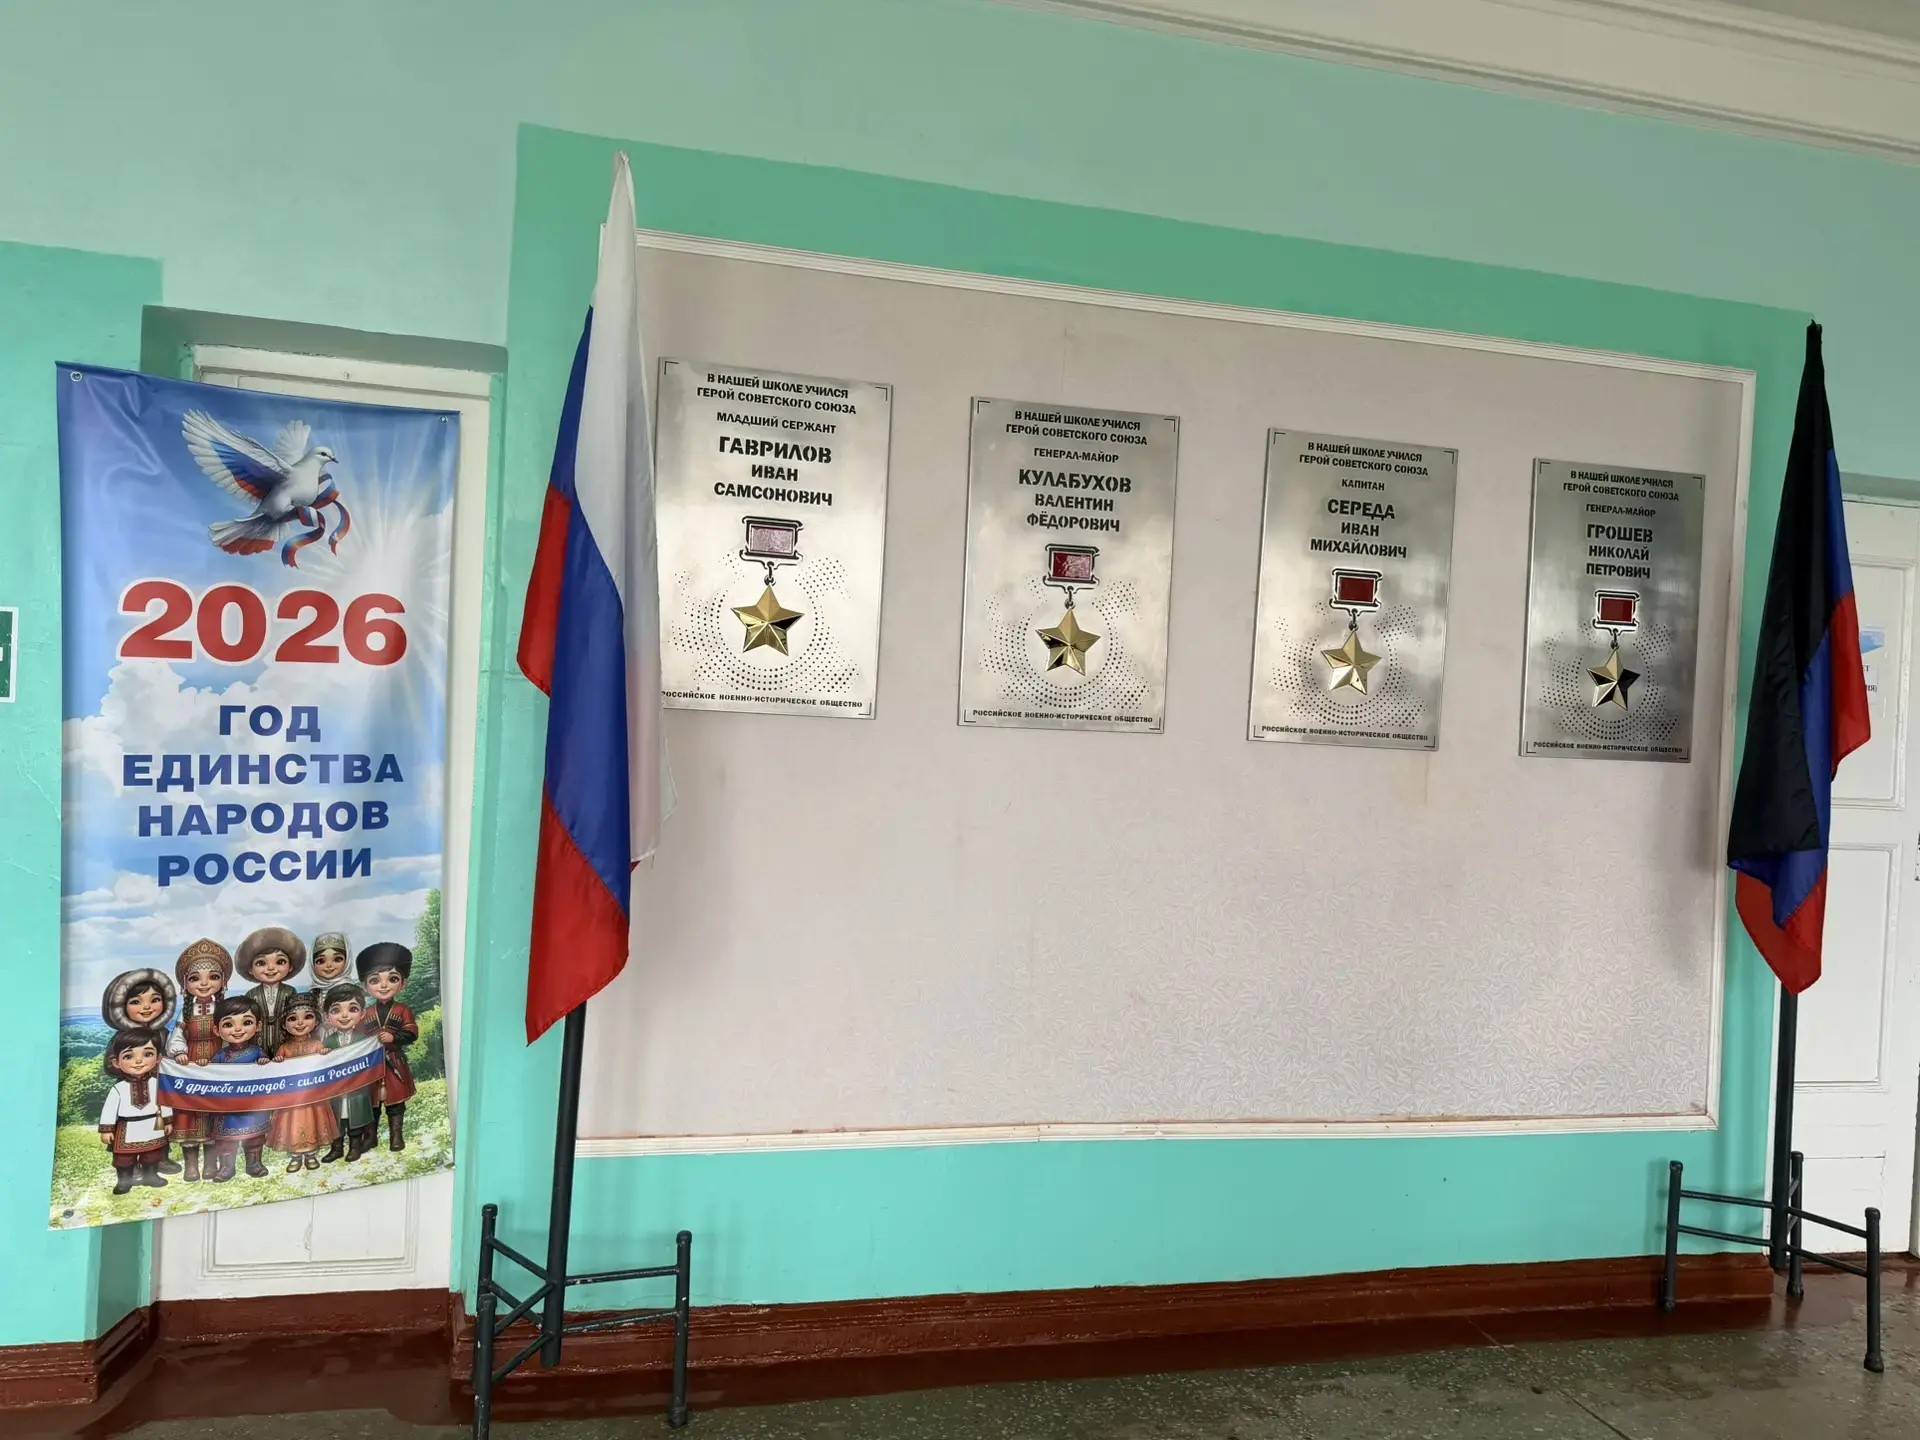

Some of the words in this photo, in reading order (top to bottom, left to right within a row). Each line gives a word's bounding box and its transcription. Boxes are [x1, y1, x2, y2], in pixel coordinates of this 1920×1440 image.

[707, 373, 715, 383] В
[718, 374, 759, 388] НАШЕЙ
[762, 380, 803, 394] ШКОЛЕ
[805, 385, 849, 399] УЧИЛСЯ
[697, 387, 735, 400] ГЕРОЙ
[738, 392, 811, 409] СОВЕТСКОГО
[815, 401, 857, 415] СОЮЗА
[716, 412, 779, 428] МЛАДШИЙ
[781, 419, 836, 434] СЕРЖАНТ
[1015, 411, 1022, 420] В
[1024, 411, 1062, 424] НАШЕЙ
[1064, 415, 1100, 427] ШКОЛЕ
[1102, 418, 1141, 431] УЧИЛСЯ
[1006, 423, 1039, 436] ГЕРОЙ
[1042, 427, 1107, 442] СОВЕТСКОГО
[1110, 433, 1148, 445] СОЮЗА
[719, 436, 832, 464] ГАВРИЛОВ
[1033, 447, 1119, 463] ГЕНЕРАЛ-МАЙОР
[1308, 442, 1314, 450] В
[1316, 442, 1350, 455] НАШЕЙ
[1352, 447, 1385, 458] ШКОЛЕ
[1387, 450, 1422, 462] УЧИЛСЯ
[751, 464, 798, 482] ИВАН
[1299, 454, 1330, 465] ГЕРОЙ
[1332, 457, 1392, 472] СОВЕТСКОГО
[1394, 464, 1428, 476] СОЮЗА
[1018, 468, 1132, 493] КУЛАБУХОВ
[1341, 478, 1385, 491] КАПИТАН
[1570, 470, 1577, 479] В
[1578, 471, 1609, 482] НАШЕЙ
[1610, 474, 1640, 485] ШКОЛЕ
[1641, 477, 1674, 488] УЧИЛСЯ
[714, 482, 833, 506] САМСОНОВИЧ
[1563, 482, 1591, 493] ГЕРОЙ
[1592, 485, 1646, 498] СОВЕТСКОГО
[1648, 490, 1679, 501] СОЮЗА
[1035, 493, 1114, 512] ВАЛЕНТИН
[1327, 498, 1395, 520] СЕРЕДА
[1586, 503, 1656, 517] ГЕНЕРАЛ-МАЙОР
[1026, 510, 1120, 532] ФЁДОРОВИЧ
[1341, 522, 1380, 537] ИВАН
[1587, 523, 1653, 543] ГРОШЕВ
[1310, 538, 1407, 558] МИХАЙЛОВИЧ
[1588, 545, 1650, 560] НИКОЛАЙ
[1586, 562, 1651, 579] ПЕТРОВИЧ
[120, 580, 407, 666] 2026
[219, 704, 321, 743] ГОД
[972, 708, 1022, 718] РОССИЙСКОЕ
[1261, 725, 1308, 734] РОССИЙСКОЕ
[123, 753, 404, 793] ЕДИНСТВА
[138, 800, 389, 839] НАРОДОВ
[157, 847, 372, 887] РОССИИ
[173, 1078, 185, 1090] В
[186, 1081, 234, 1095] дружбе
[236, 1079, 286, 1095] народов
[297, 1074, 325, 1087] сила
[327, 1058, 370, 1081] России!
